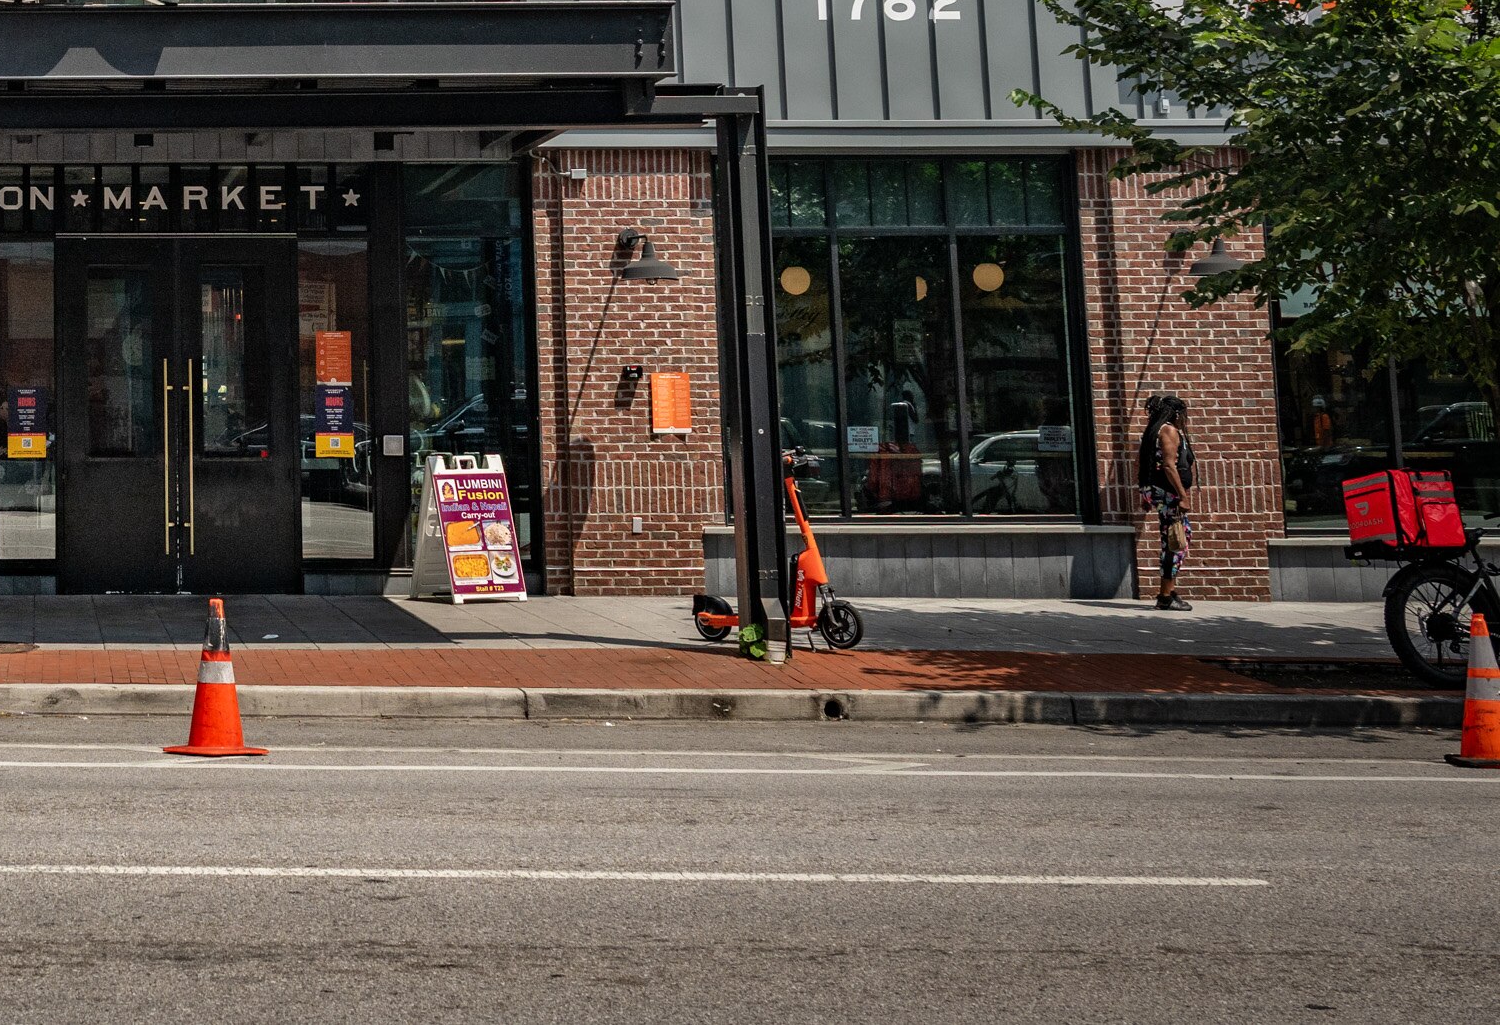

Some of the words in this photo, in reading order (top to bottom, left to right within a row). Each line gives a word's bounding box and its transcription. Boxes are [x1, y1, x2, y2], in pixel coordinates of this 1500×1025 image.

[104, 186, 325, 211] MARKET
[456, 479, 502, 489] LUMBINI
[458, 489, 504, 500] Fusion
[441, 502, 470, 511] Indian
[461, 512, 496, 520] Carry-out
